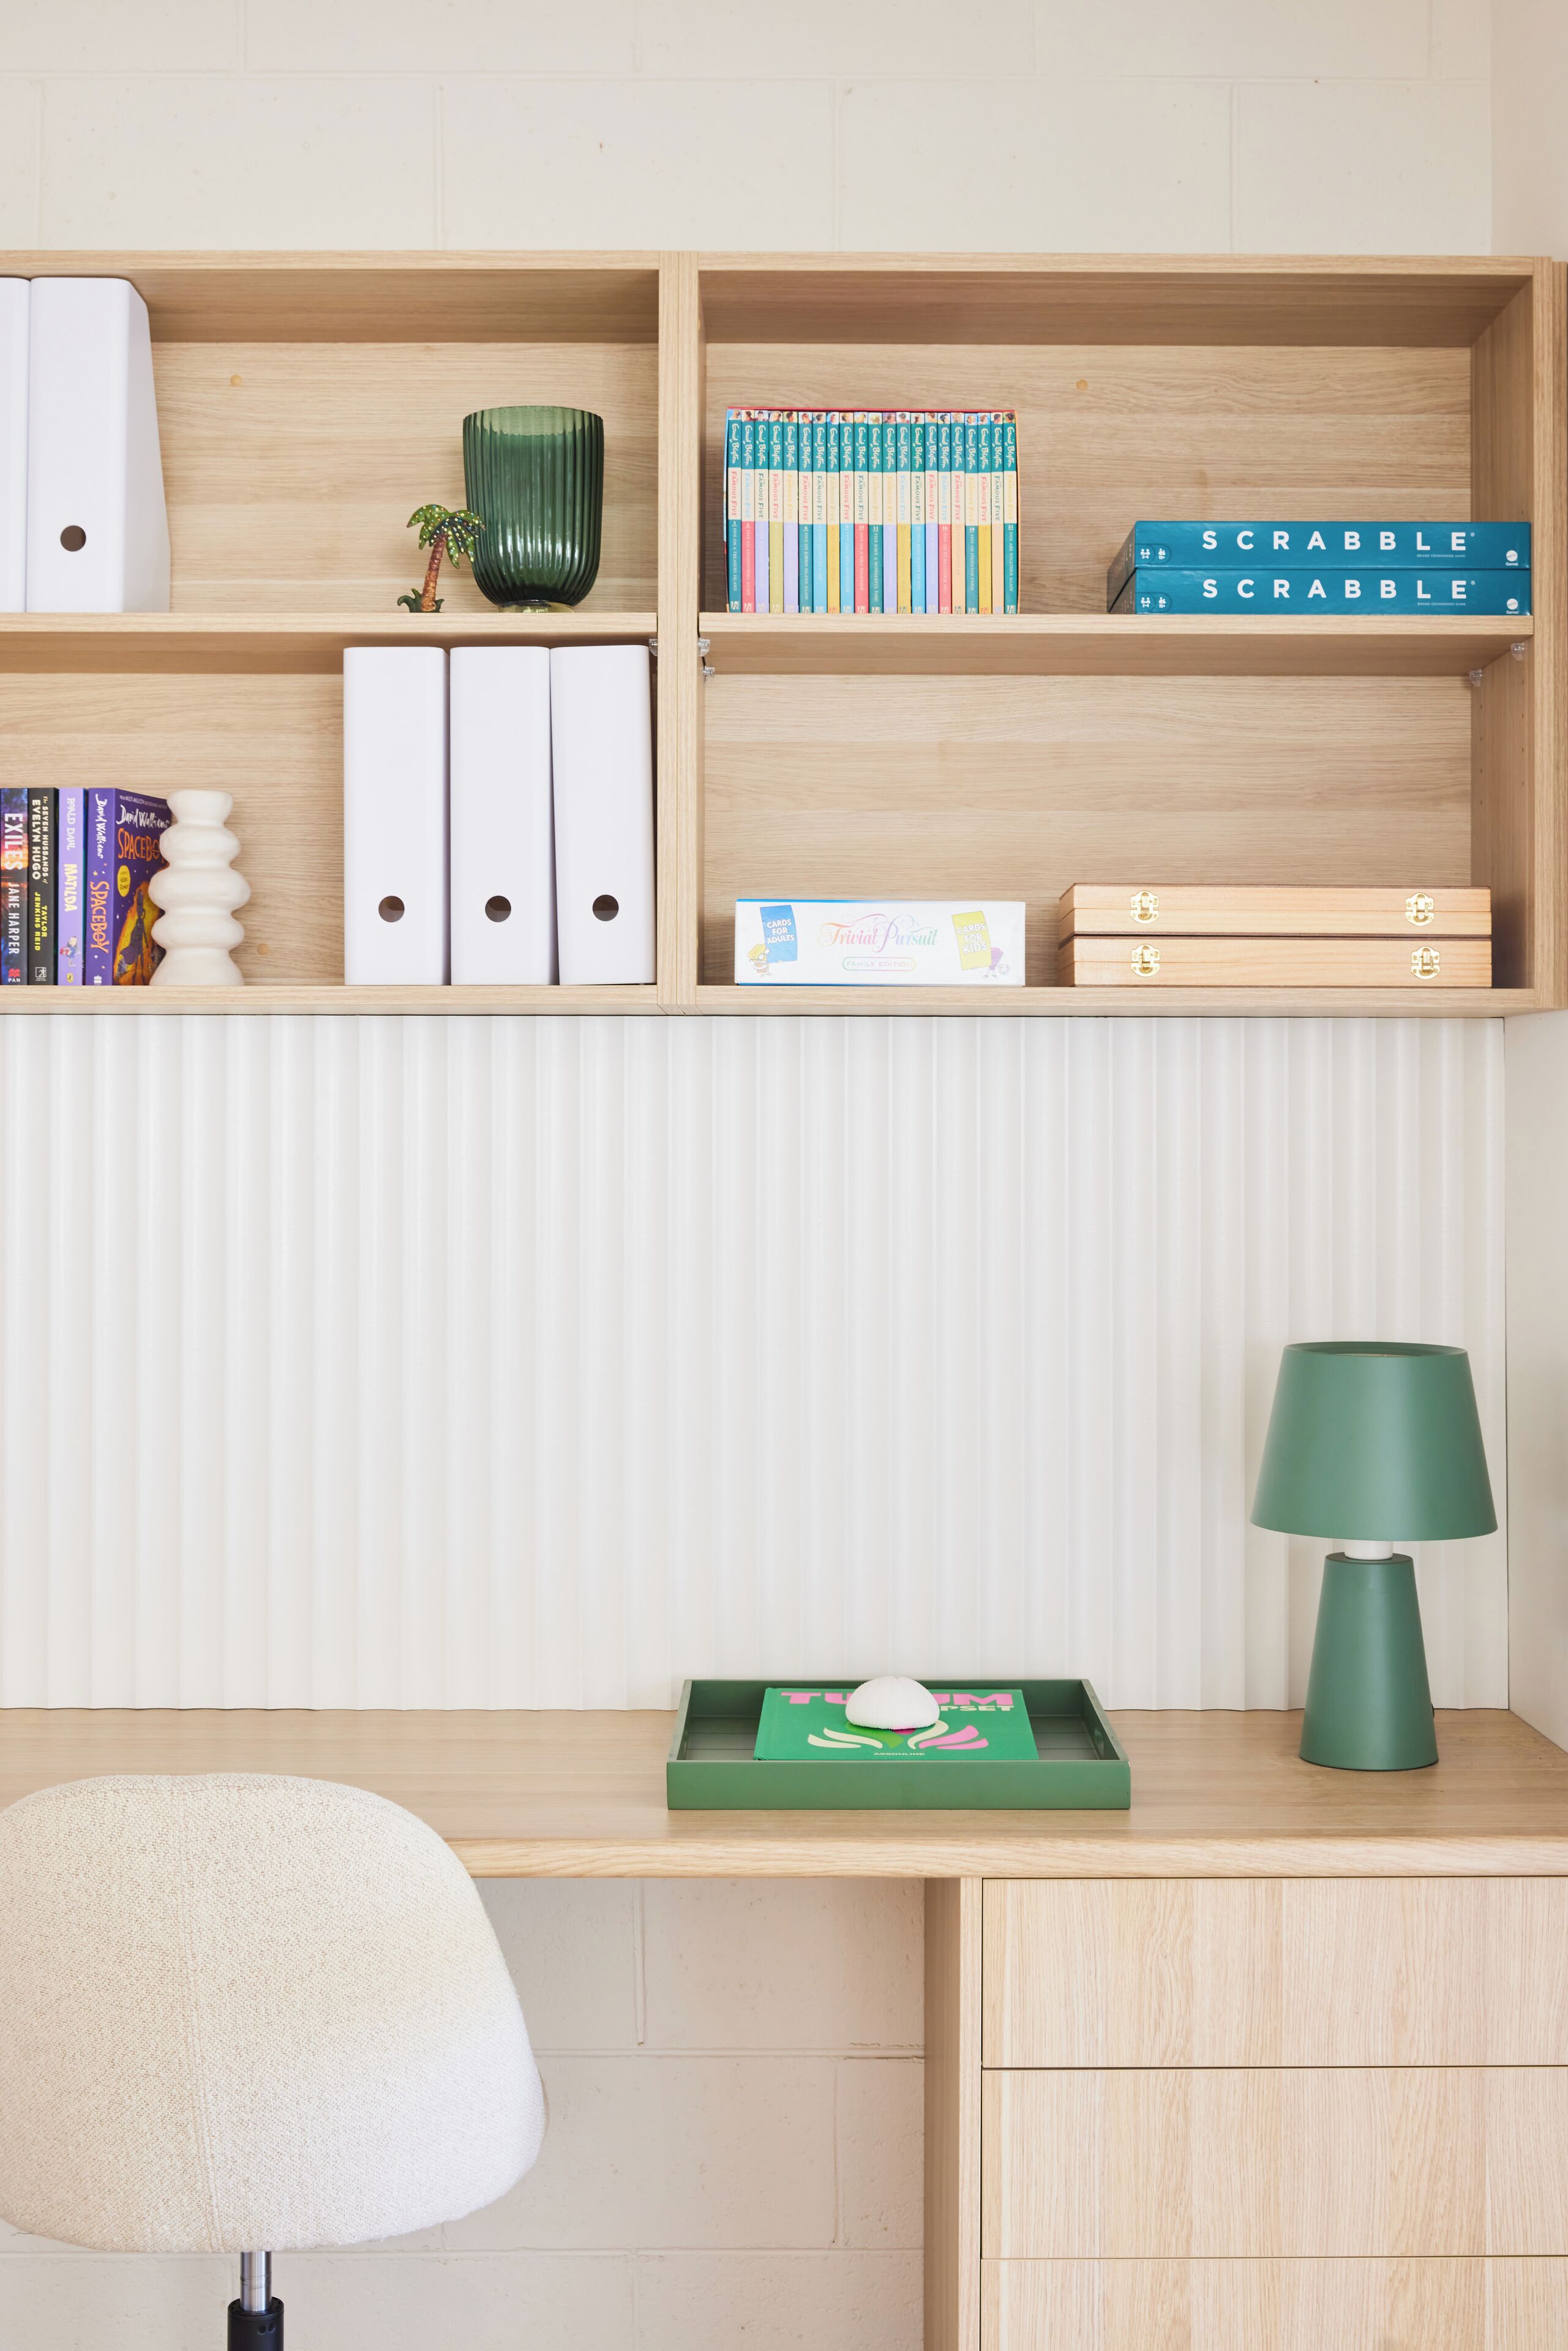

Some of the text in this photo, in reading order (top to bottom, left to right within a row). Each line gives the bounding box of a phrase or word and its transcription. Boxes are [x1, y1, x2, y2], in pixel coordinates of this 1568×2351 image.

[730, 442, 739, 465] Blyton
[743, 443, 752, 467] Blyton
[757, 443, 766, 467] Blyton
[771, 444, 780, 467] Blyton
[786, 444, 795, 467] Blyton
[801, 446, 810, 468] Blyton
[816, 446, 824, 468] Blyton
[828, 446, 838, 469] Blyton
[842, 446, 851, 468] Blyton
[857, 446, 866, 468] Blyton
[871, 446, 880, 469] Blyton
[886, 446, 895, 469] Blyton
[899, 446, 907, 468] Blyton
[914, 446, 923, 469] Blyton
[928, 444, 936, 467] Blyton
[940, 446, 948, 468] Blyton
[954, 446, 962, 468] Blyton
[967, 448, 975, 470] Blyton
[980, 447, 988, 470] Blyton
[993, 446, 1002, 469] Blyton
[1006, 446, 1015, 468] Blyton
[1202, 531, 1466, 550] SCRABBLE
[1202, 579, 1467, 599] SCRABBLE
[67, 797, 76, 851] ROALD DAHL
[95, 793, 108, 859] David Walliams
[116, 804, 170, 829] David Walliams
[4, 813, 23, 870] EXILES
[32, 799, 41, 880] EVELYN HUGO
[118, 828, 165, 863] SPACEBO
[64, 863, 78, 912] MATILDA
[8, 882, 20, 954] JANE HARPER
[90, 881, 110, 954] SPACEBOY
[767, 919, 792, 928] CARDS
[958, 924, 985, 934] CARDS
[768, 935, 795, 944] ADULTS
[772, 927, 788, 936] FOR
[818, 915, 939, 953] Trivial Pursuit
[965, 934, 981, 943] FOR
[963, 942, 987, 954] KIDS
